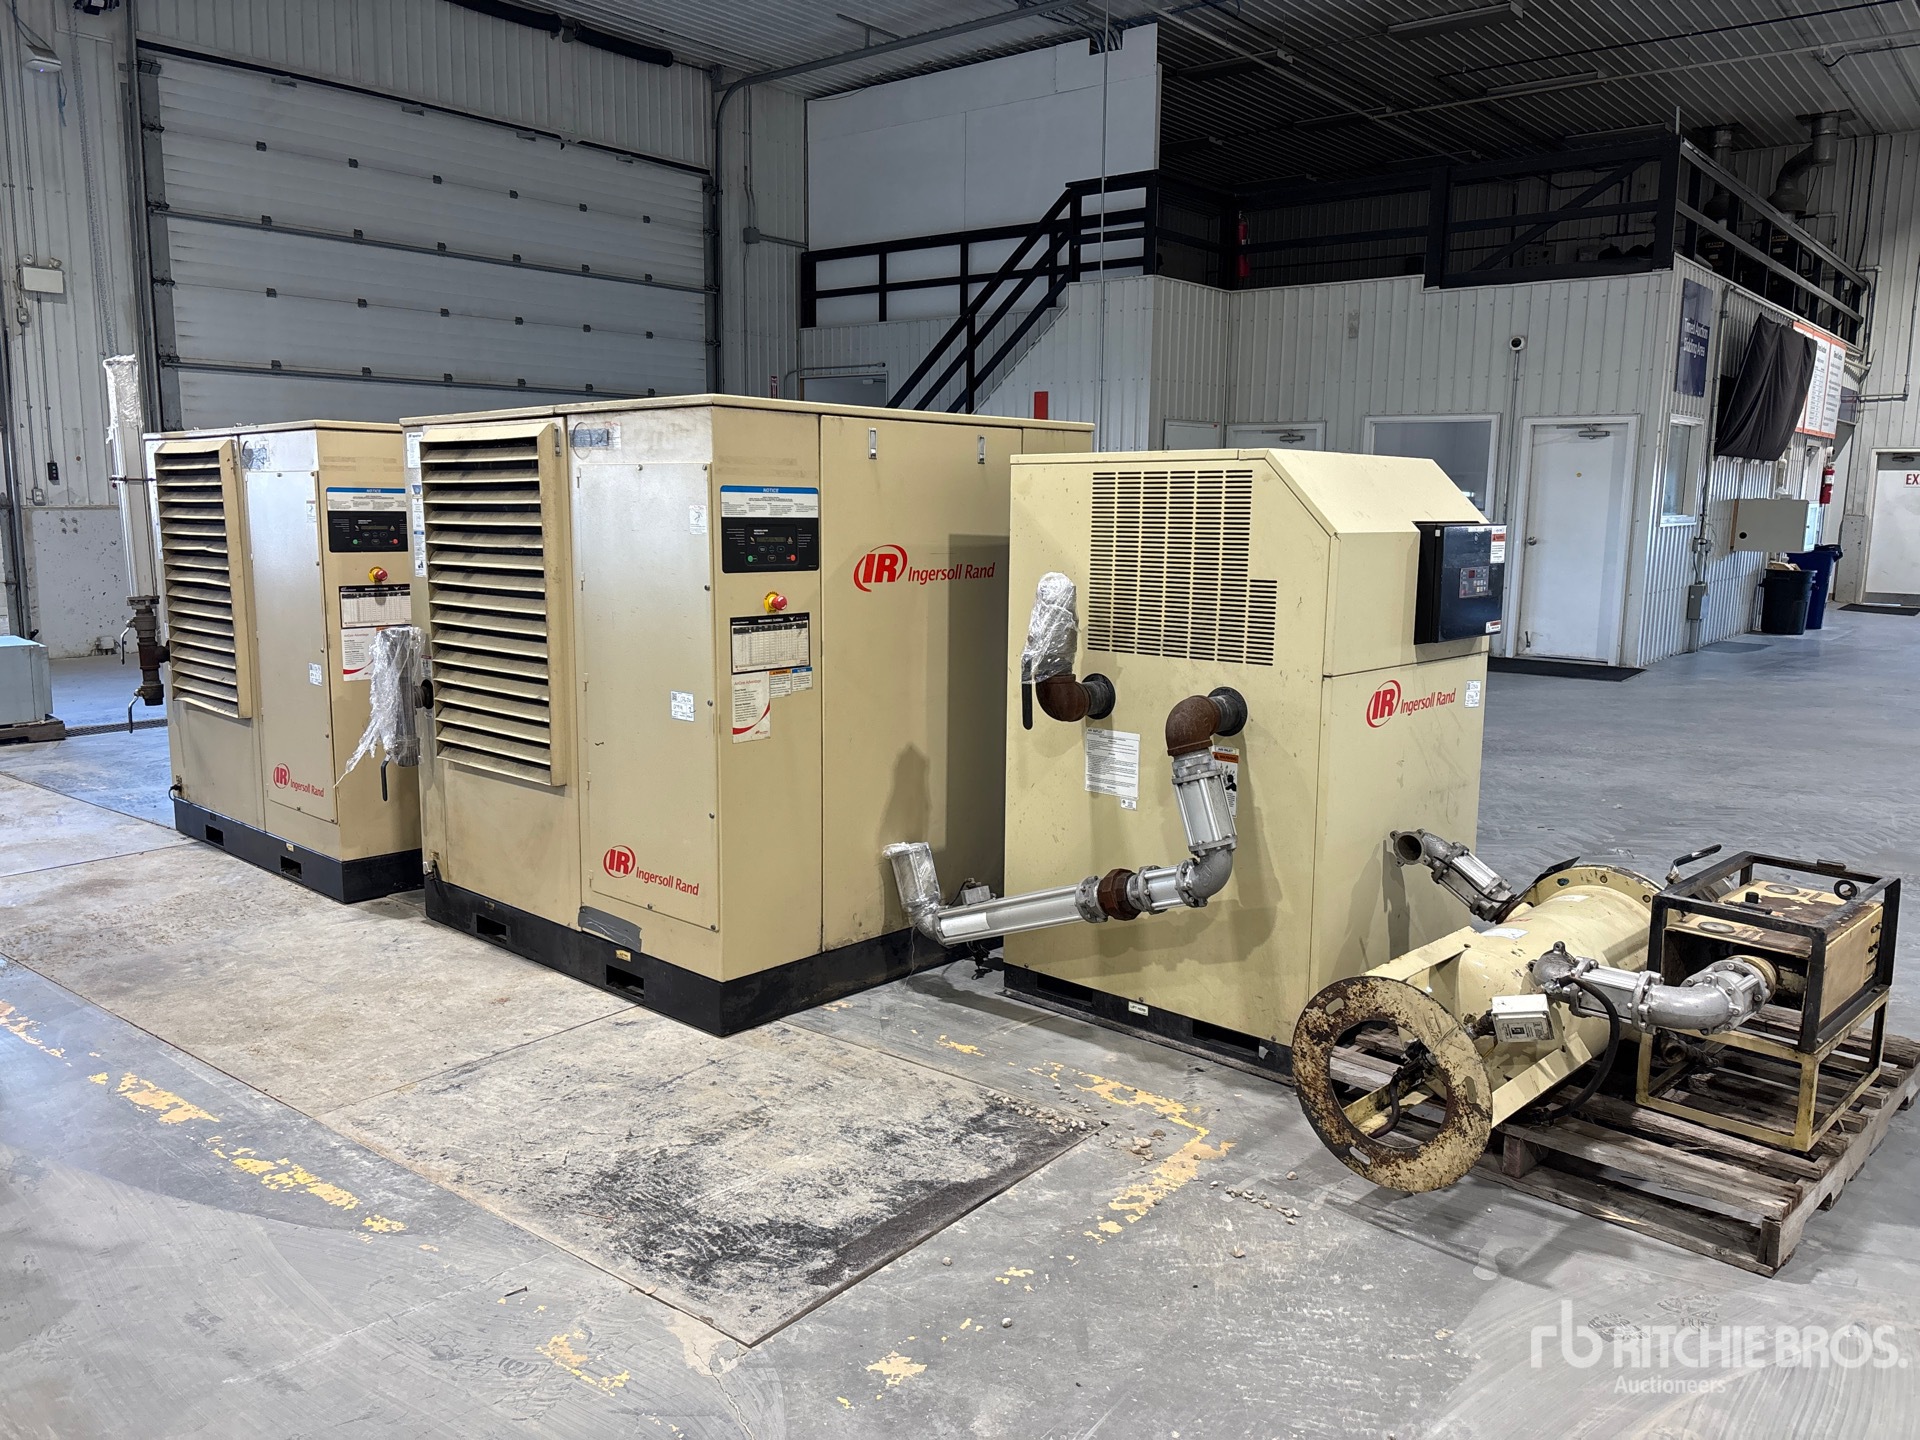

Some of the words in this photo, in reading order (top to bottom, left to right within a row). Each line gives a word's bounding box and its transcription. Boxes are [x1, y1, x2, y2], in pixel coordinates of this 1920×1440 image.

[907, 563, 963, 586] Ingersoll
[964, 562, 996, 580] Rand
[1400, 691, 1436, 716] Ingersoll
[1436, 687, 1457, 707] Rand
[290, 778, 311, 794] Ingersoll
[311, 784, 325, 798] Rand
[635, 866, 674, 889] Ingersoll
[675, 877, 700, 896] Rand
